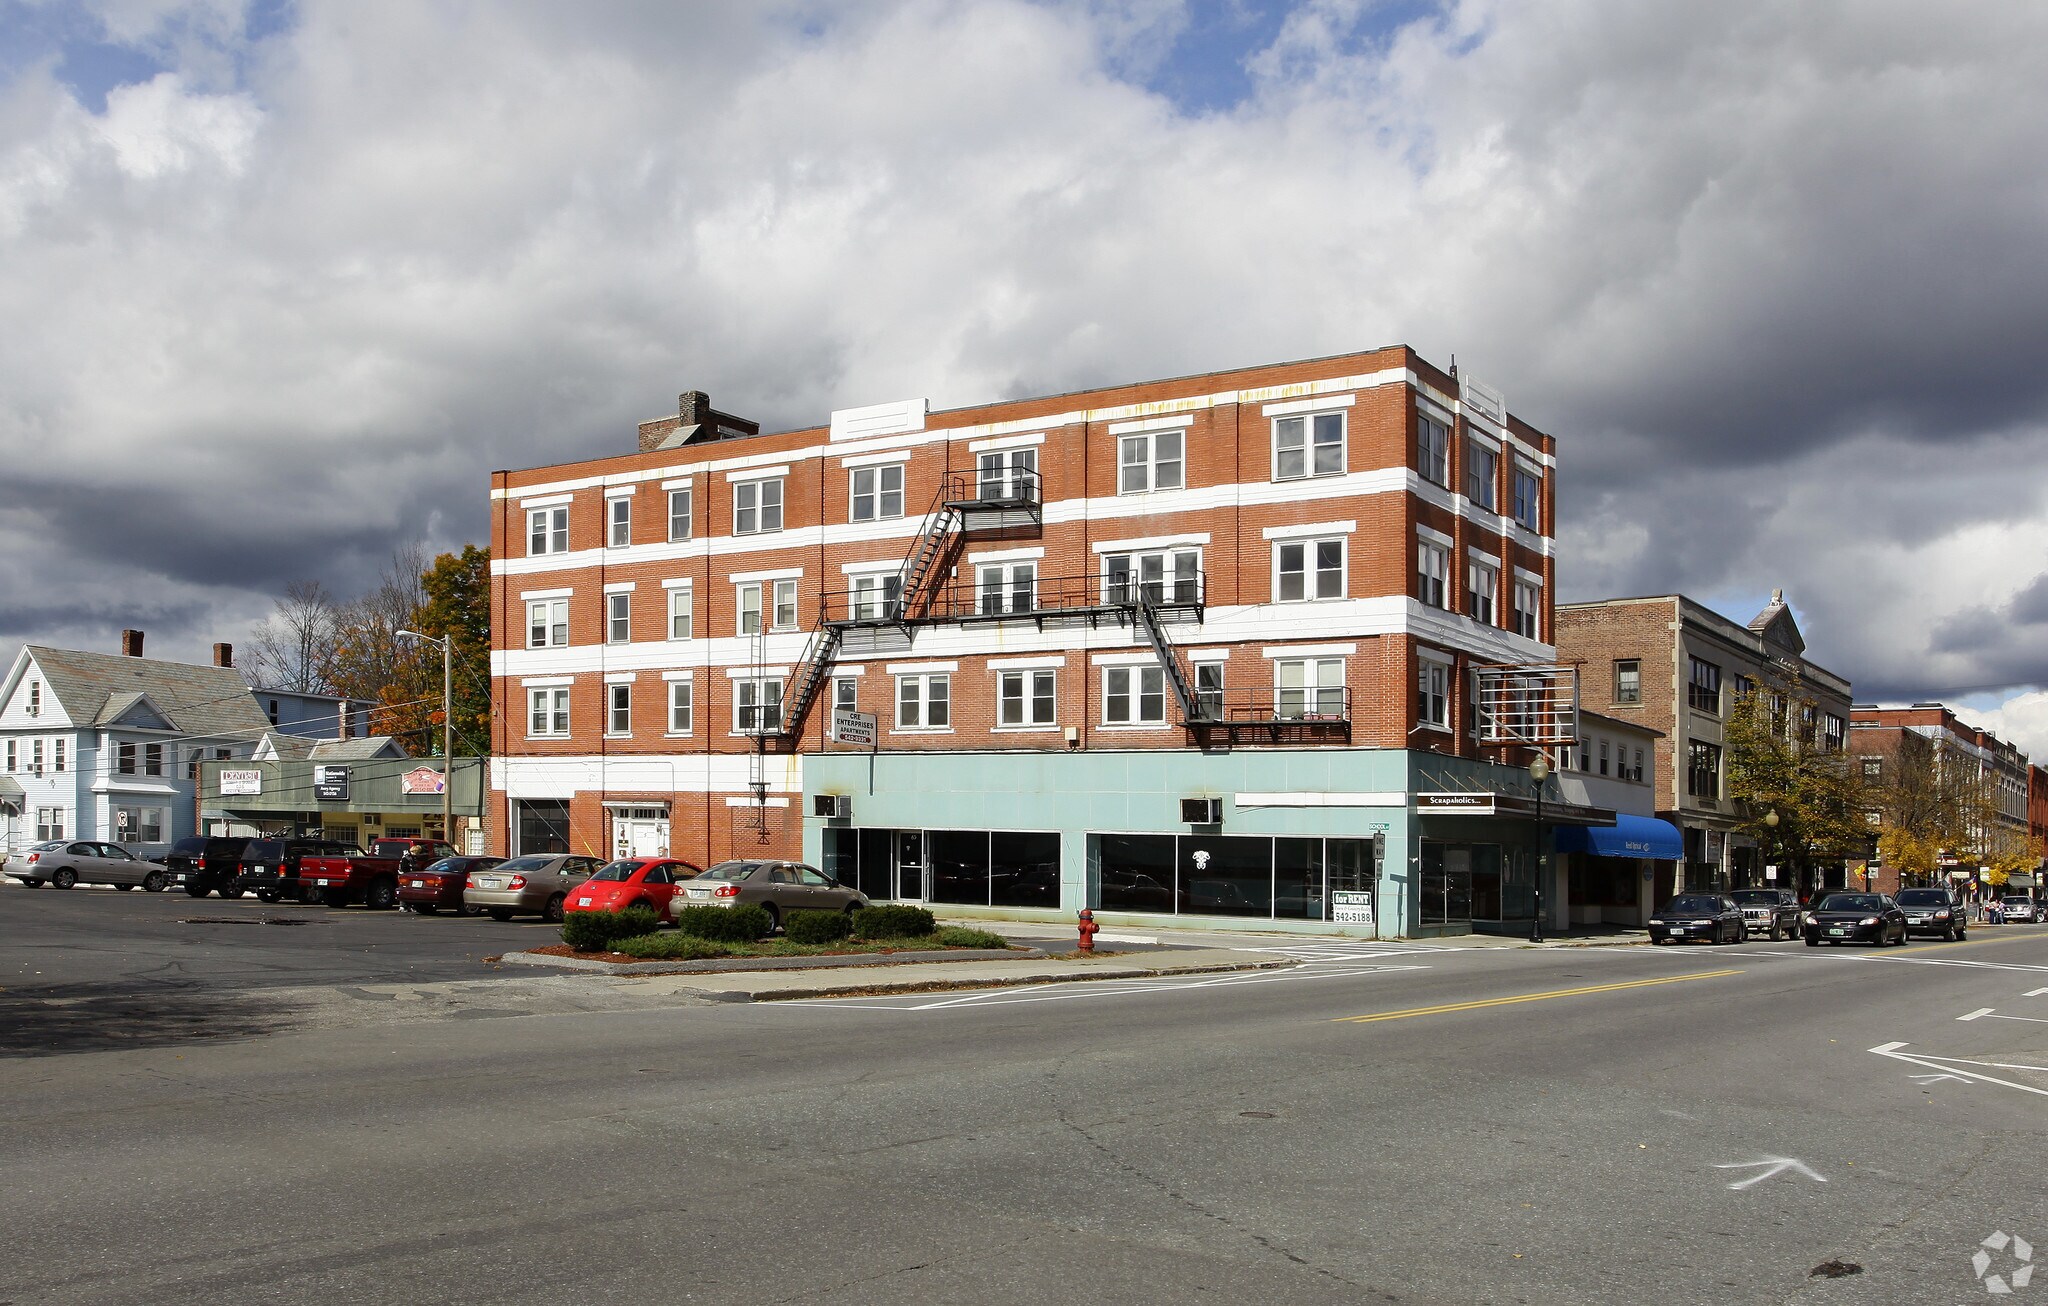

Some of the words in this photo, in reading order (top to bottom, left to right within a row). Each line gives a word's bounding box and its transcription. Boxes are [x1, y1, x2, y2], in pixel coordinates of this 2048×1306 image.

[837, 719, 873, 729] ENTERPRISES
[841, 727, 870, 736] APARTMENTS
[1335, 894, 1347, 903] for
[1347, 894, 1369, 904] RENT
